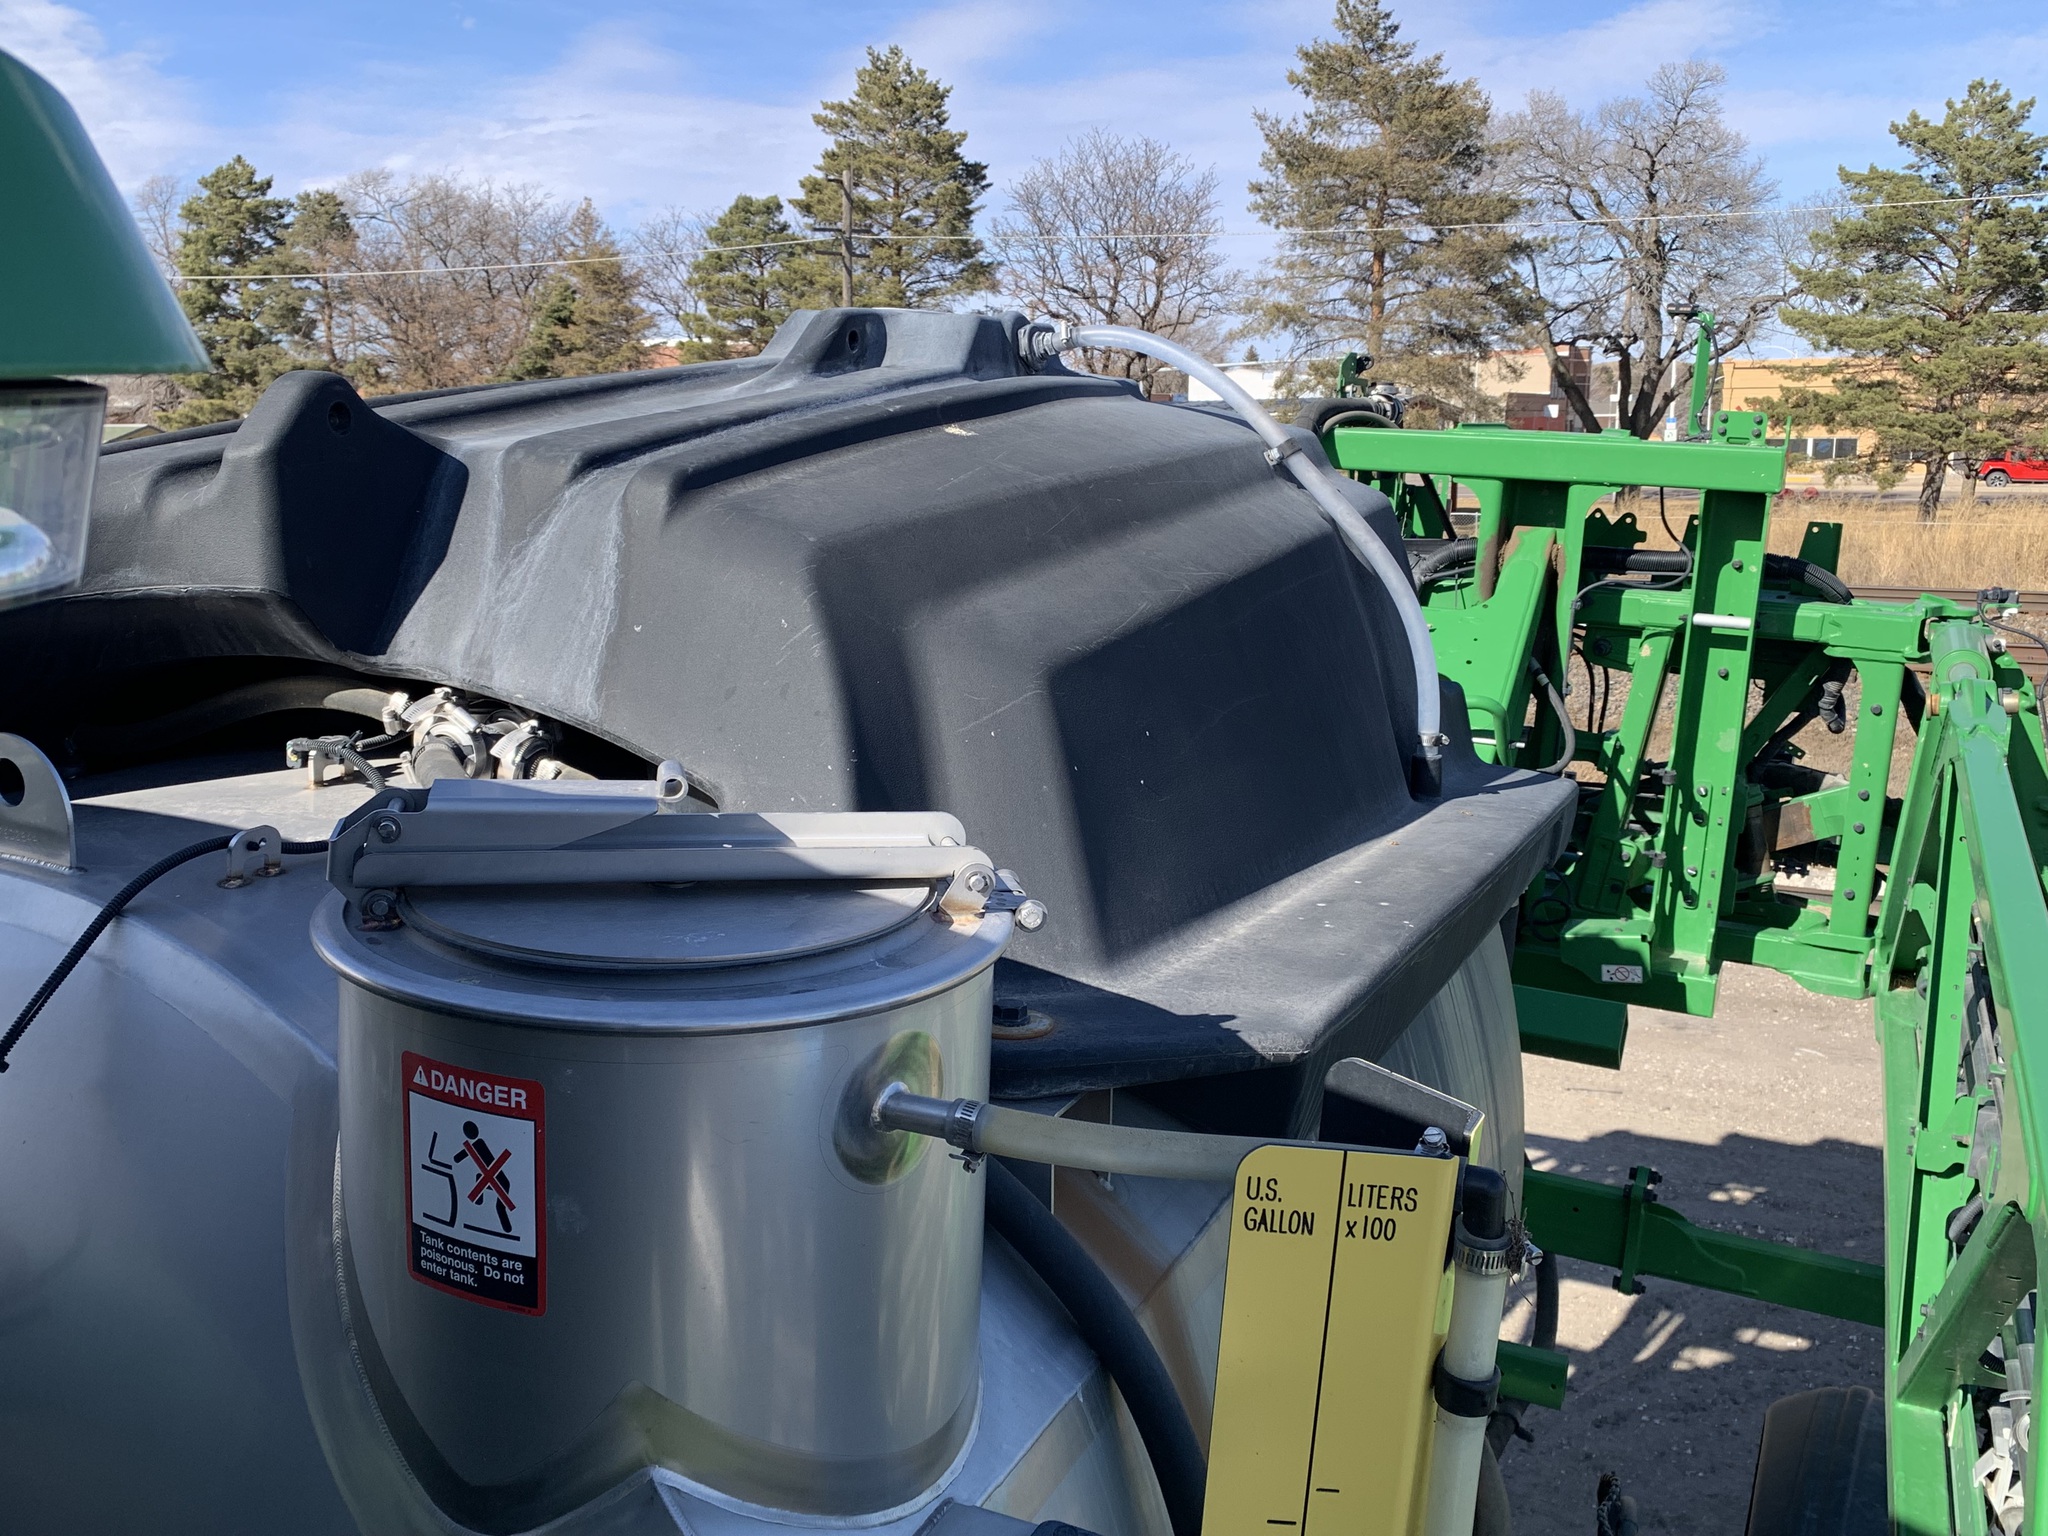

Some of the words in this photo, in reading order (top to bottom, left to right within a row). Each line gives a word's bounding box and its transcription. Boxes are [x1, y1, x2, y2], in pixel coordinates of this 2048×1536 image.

[430, 1069, 527, 1110] DANGER
[1246, 1175, 1283, 1203] U.S.
[1347, 1183, 1419, 1213] LITERS
[1243, 1206, 1315, 1236] GALLON
[1345, 1214, 1397, 1241] x100
[420, 1230, 444, 1250] Tank
[447, 1242, 498, 1266] contents
[502, 1257, 523, 1271] are
[420, 1246, 478, 1274] poisonous.
[483, 1265, 500, 1280] Do
[504, 1271, 524, 1285] not
[420, 1260, 447, 1277] enter
[450, 1268, 478, 1287] tank.
